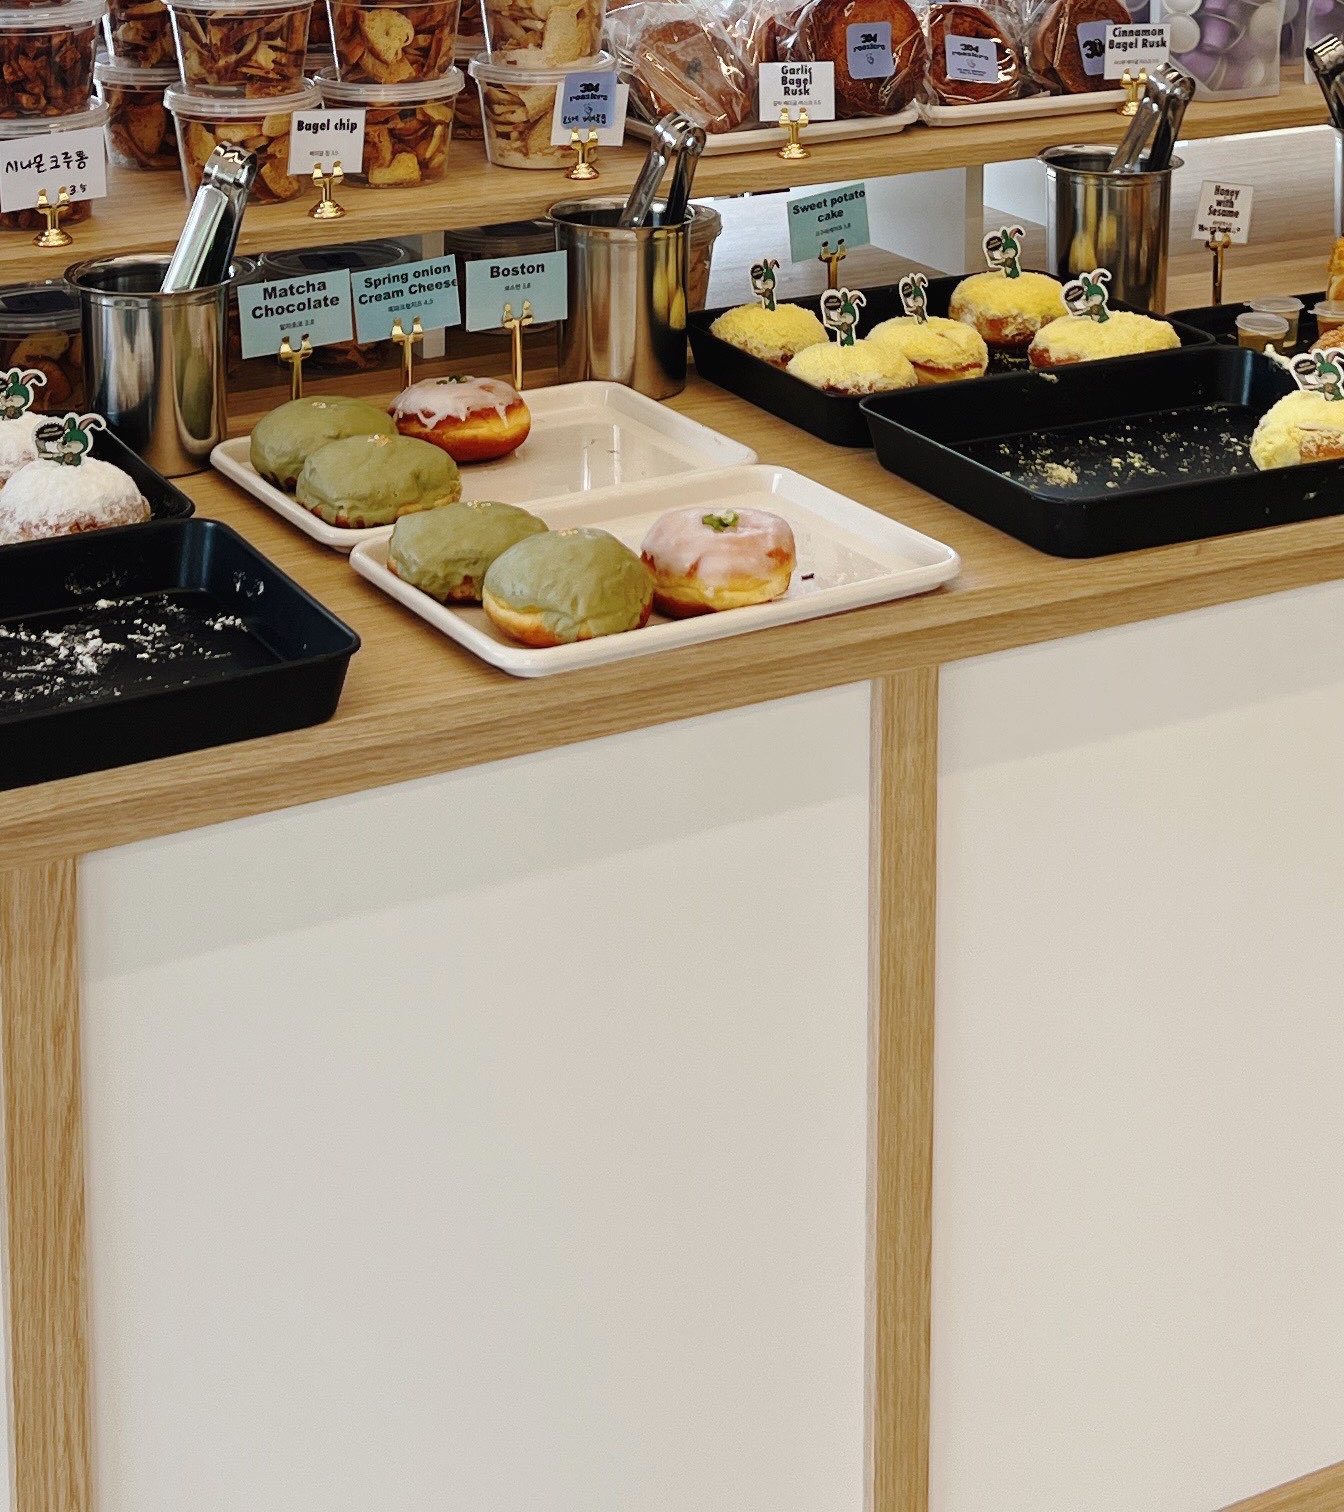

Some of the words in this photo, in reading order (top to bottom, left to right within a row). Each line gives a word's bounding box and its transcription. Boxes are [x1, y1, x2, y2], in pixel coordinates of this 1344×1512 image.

[1112, 26, 1165, 38] Cinnamon
[1082, 38, 1105, 59] 30
[1108, 38, 1138, 52] Bagel
[1141, 37, 1167, 49] Rusk
[780, 63, 813, 75] Garlic
[780, 72, 813, 88] Bagel
[783, 85, 811, 96] Rusk
[297, 118, 331, 134] Bagel
[334, 118, 358, 133] chip
[792, 198, 828, 215] Sweet
[829, 190, 866, 207] potato
[817, 209, 845, 223] cake
[364, 272, 409, 290] Spring
[412, 264, 452, 279] onion
[489, 262, 546, 279] Boston
[262, 280, 327, 301] Matcha
[358, 288, 404, 305] Cream
[408, 278, 458, 296] Cheese
[251, 295, 340, 320] Chocolate
